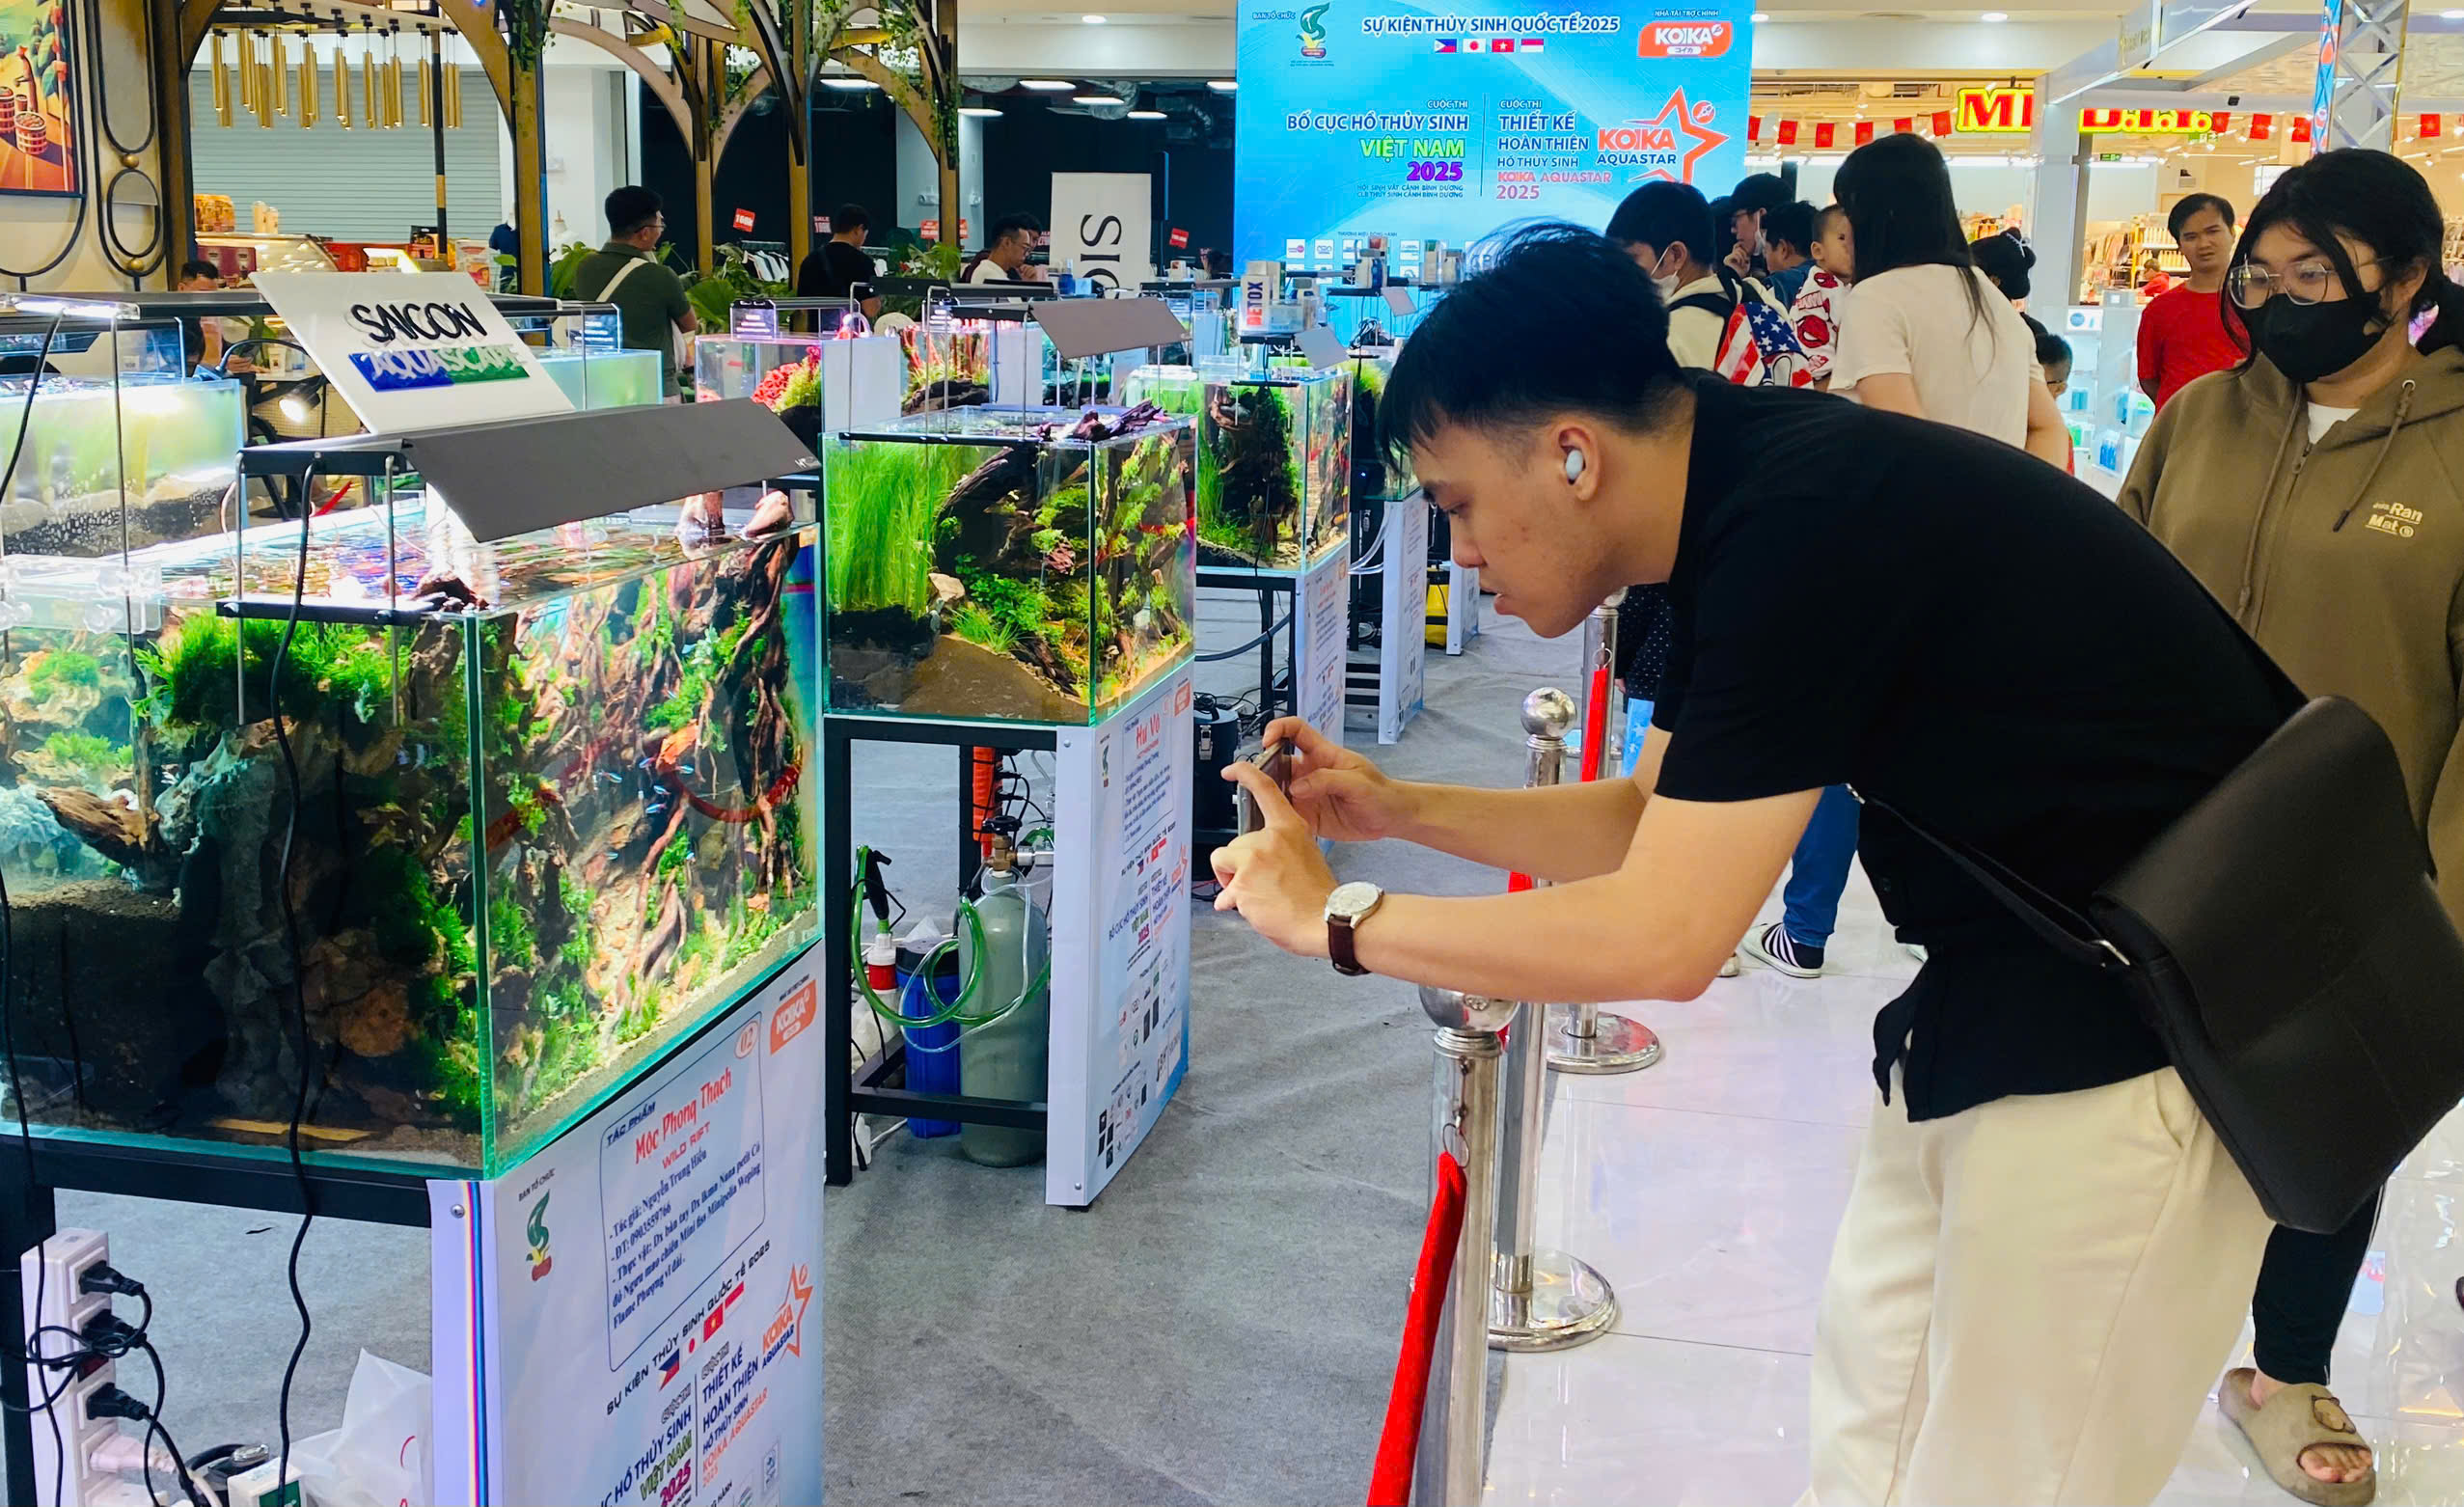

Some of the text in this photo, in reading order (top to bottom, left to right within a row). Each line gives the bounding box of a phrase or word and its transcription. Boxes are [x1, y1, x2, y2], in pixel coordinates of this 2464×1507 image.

[1363, 12, 1620, 38] SỰ KIỆN THỦY SINH QUỐC TẾ 2025
[1656, 27, 1713, 45] KOIKA
[1428, 100, 1468, 110] CUỘC THI
[1287, 110, 1311, 130] BỐ
[1314, 116, 1347, 133] CỤC
[1380, 112, 1424, 130] THỦY
[1428, 116, 1468, 130] SINH
[1500, 110, 1576, 130] THIẾT KẾ
[1360, 134, 1465, 162] VIỆT NAM
[1498, 135, 1589, 154] HOÀN THIỆN
[1598, 128, 1677, 151] KOIKA
[1518, 155, 1548, 167] THỦY
[1551, 157, 1578, 167] SINH
[1598, 153, 1677, 165] AQUASTAR
[1407, 161, 1463, 181] 2025
[1497, 172, 1611, 183] KOIKA AQUASTAR
[1496, 184, 1540, 199] 2025
[2368, 513, 2398, 531] Mat
[2389, 502, 2423, 522] Ran
[662, 1100, 697, 1139] Phong
[700, 1067, 731, 1108] Thạch
[662, 1121, 710, 1168] WILD RIFT
[670, 1164, 690, 1187] Trung
[606, 1391, 621, 1416] SỰ
[625, 1364, 648, 1397] KIỆN
[652, 1332, 679, 1366] THỦY
[682, 1306, 704, 1337] SINH
[708, 1277, 732, 1310] QUỐC
[749, 1240, 770, 1270] 2025
[762, 1303, 793, 1355] KOIKA
[762, 1324, 795, 1370] AQUASTAR
[702, 1360, 729, 1403] THIẾT
[702, 1356, 758, 1434] HOÀN THIỆN
[729, 1387, 768, 1441] AQUASTAR
[635, 1434, 664, 1480] THỦY
[667, 1405, 691, 1445] SINH
[640, 1459, 666, 1501] VIỆT
[667, 1430, 693, 1474] NAM
[660, 1459, 692, 1507] 2025
